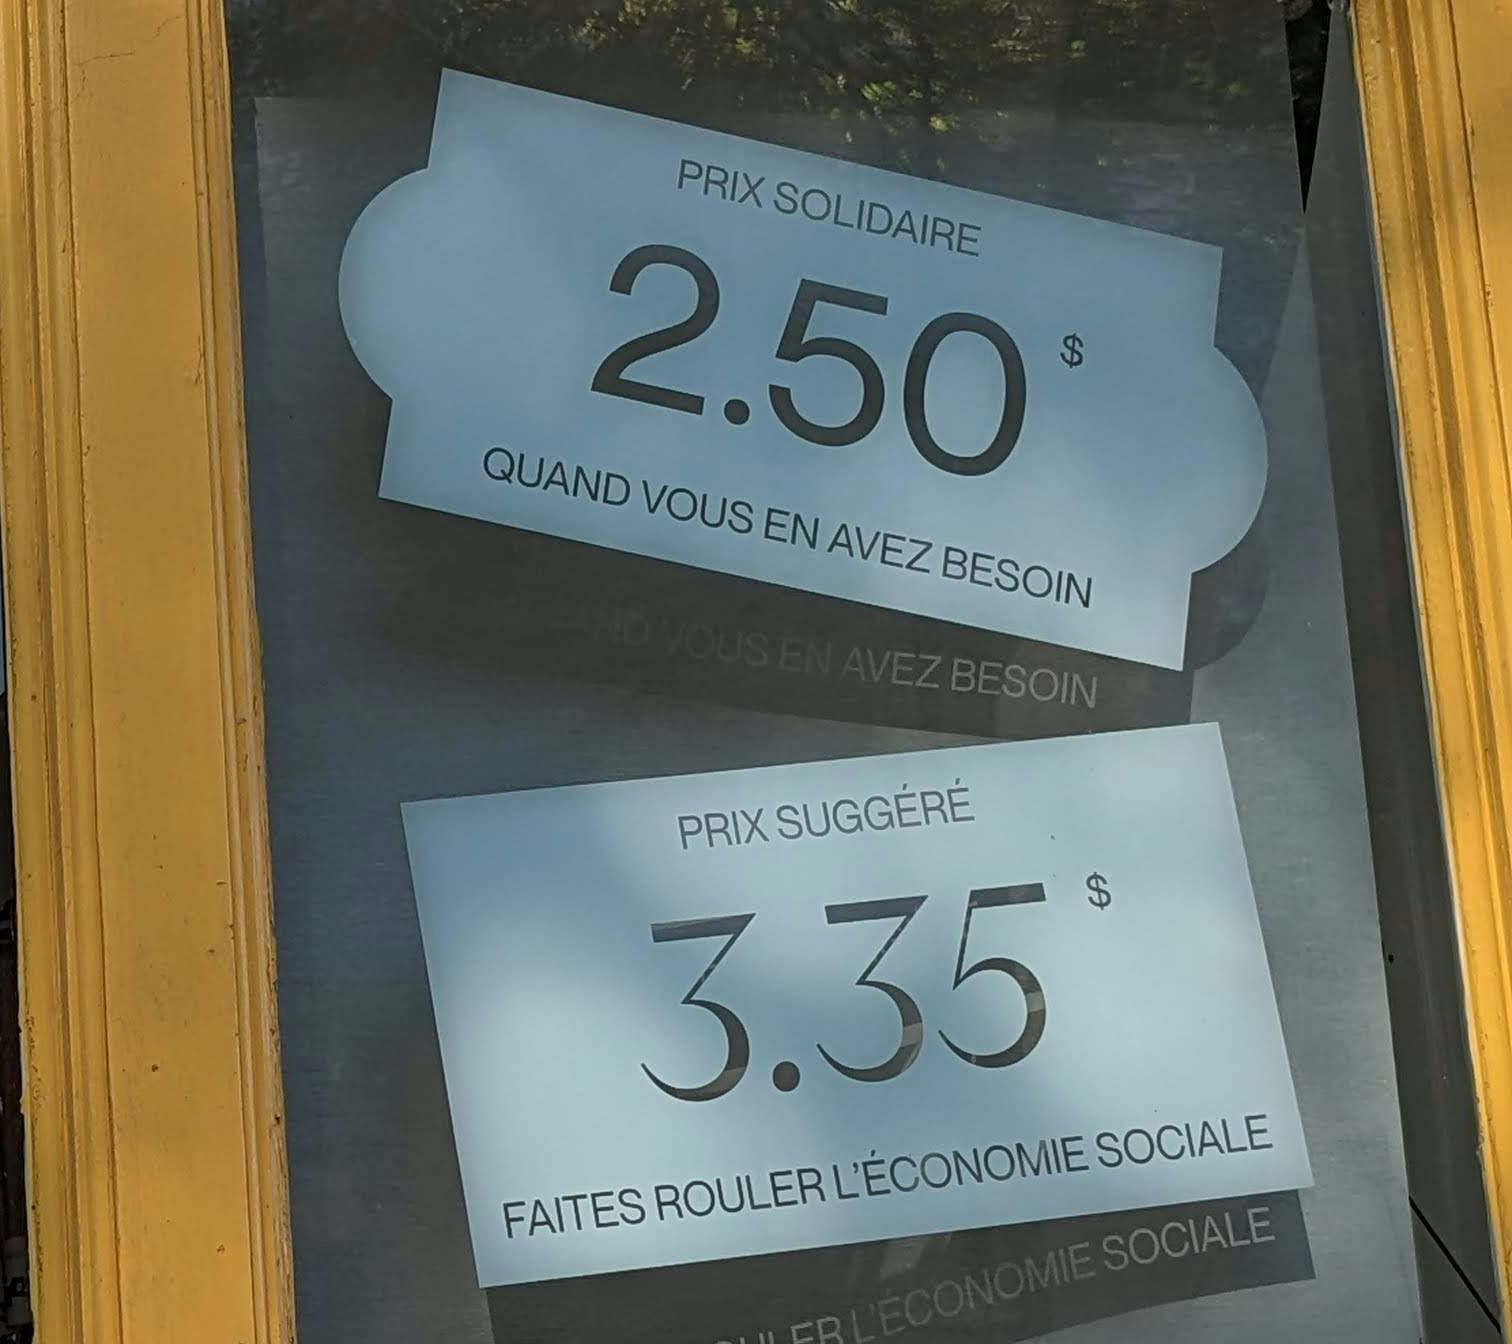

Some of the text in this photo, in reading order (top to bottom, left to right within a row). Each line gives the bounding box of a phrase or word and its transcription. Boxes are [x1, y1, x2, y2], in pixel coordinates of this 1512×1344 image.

[676, 159, 982, 257] PRIX SOLIDAIRE
[590, 243, 1028, 477] 2.50
[482, 446, 1093, 610] QUAND VOUS EN AVEZ BESOIN
[677, 777, 976, 850] PRIX SUGGÉRÉ
[640, 882, 1047, 1103] 3.35
[502, 1113, 1274, 1240] FAITES ROULER L'ÉCONOMIE SOCIALE
